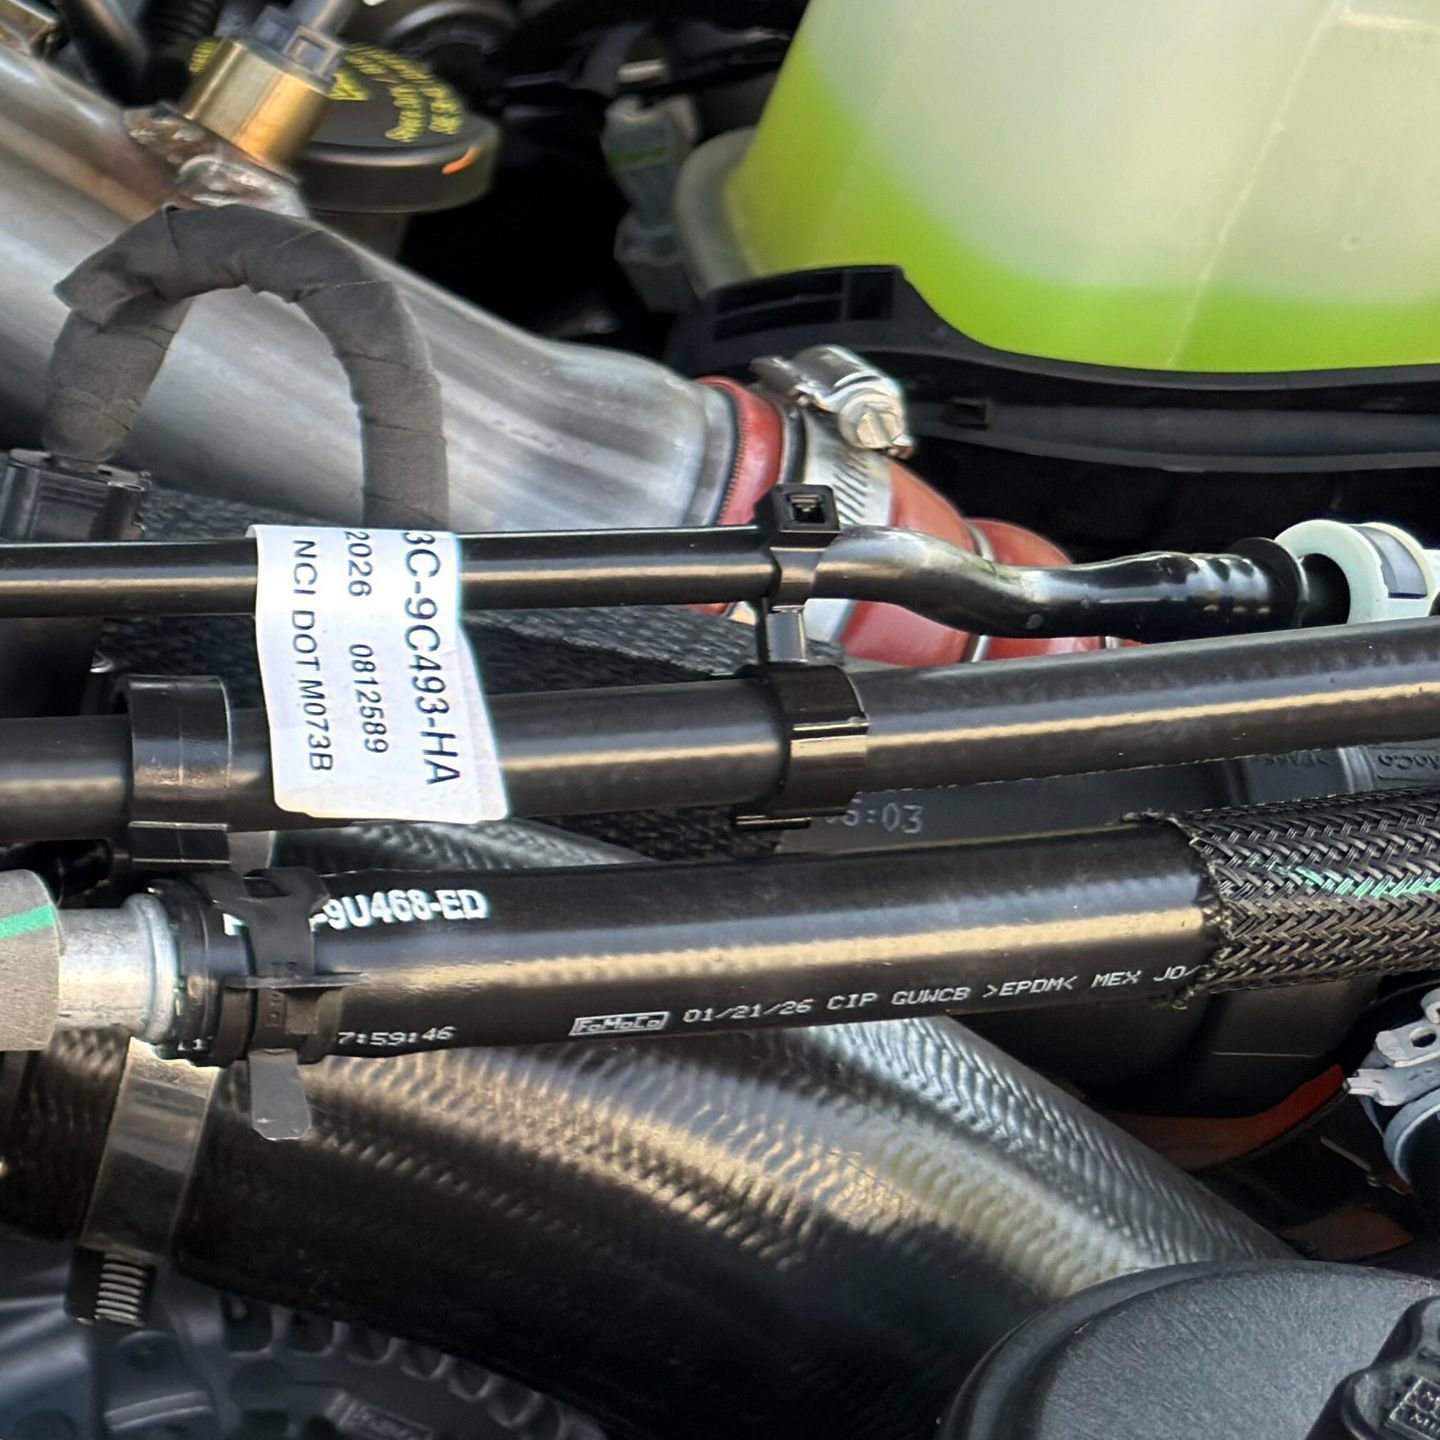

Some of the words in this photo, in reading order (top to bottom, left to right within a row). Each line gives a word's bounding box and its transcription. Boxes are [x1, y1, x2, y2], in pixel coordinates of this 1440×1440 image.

[292, 539, 319, 596] NCI
[343, 530, 374, 598] 2026
[291, 609, 321, 672] DOT
[401, 530, 461, 786] 3C-9C493-HA
[297, 679, 334, 773] M073B
[348, 643, 390, 754] 0812589
[309, 888, 492, 933] -9U468-ED
[682, 997, 813, 1024] 01/21/26
[826, 991, 878, 1012] CIP
[890, 984, 971, 1007] GUWCB
[1091, 967, 1142, 989] MEX
[1152, 963, 1198, 984] JO/
[337, 1024, 457, 1049] 7:59:46
